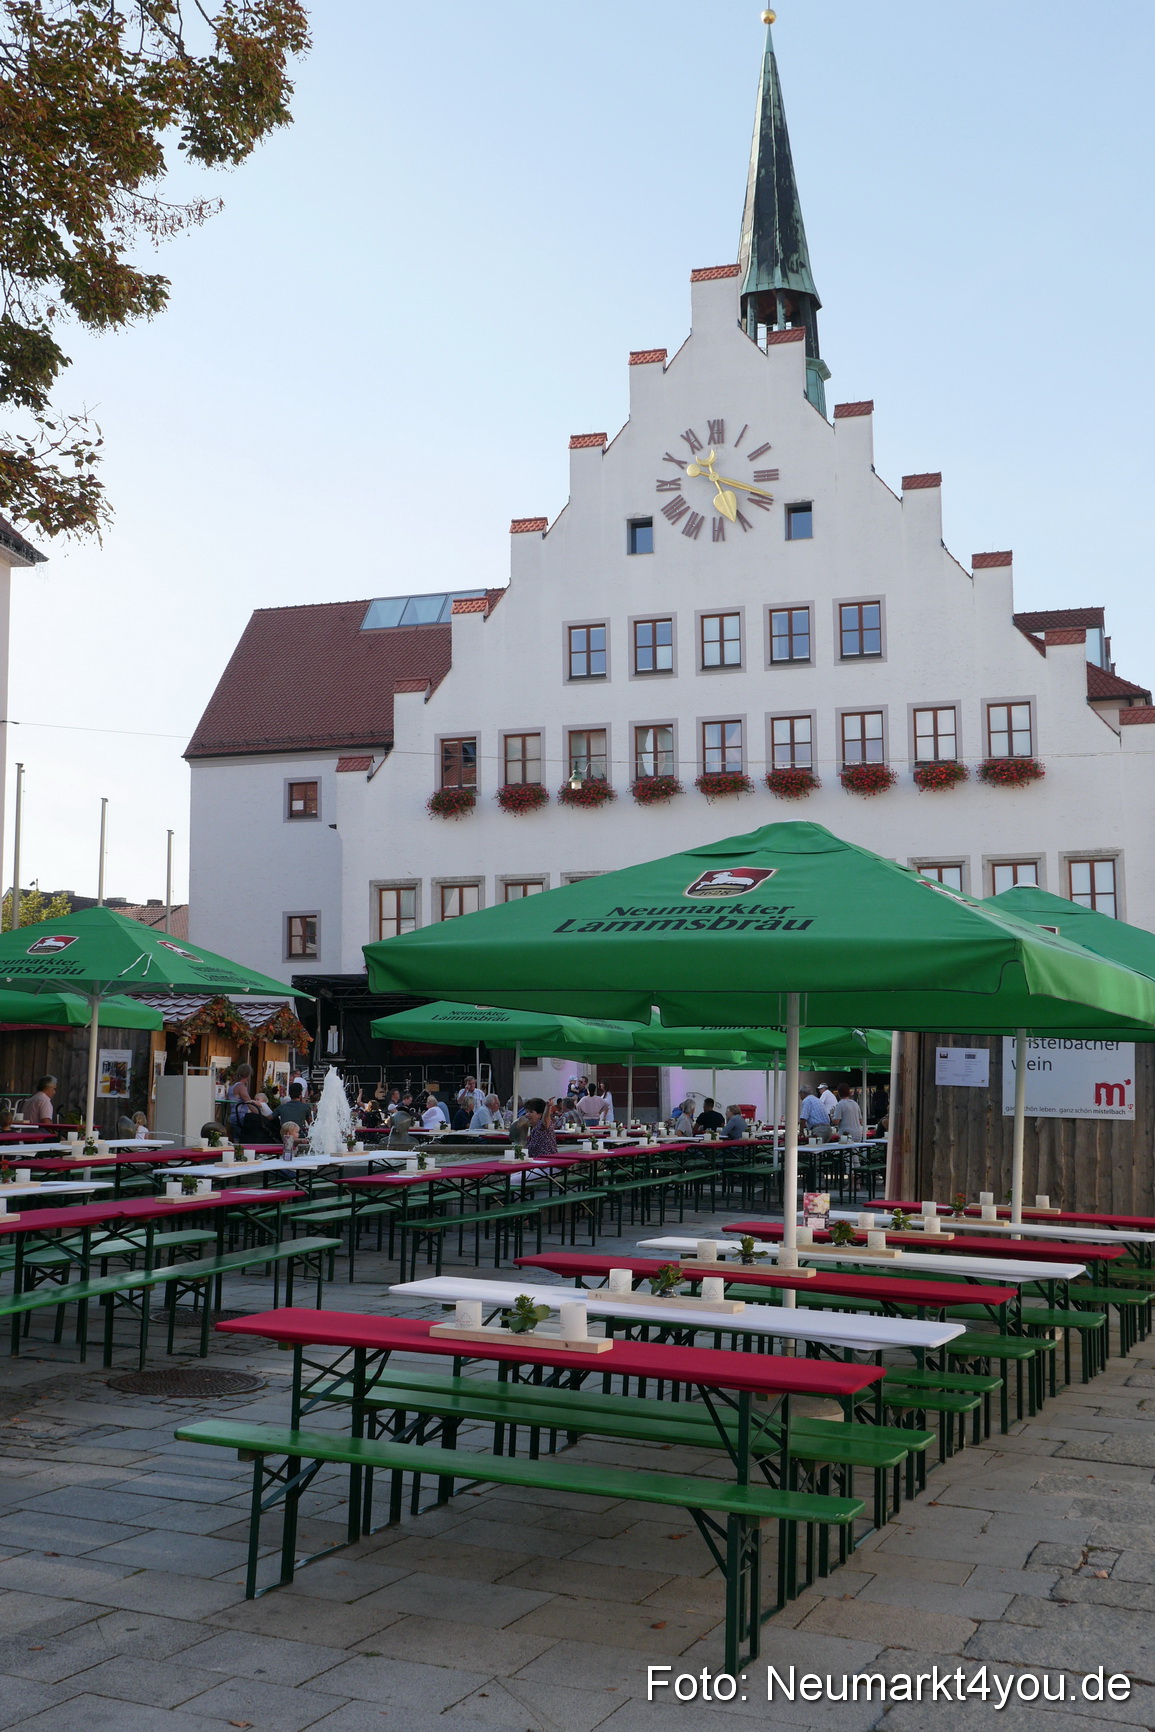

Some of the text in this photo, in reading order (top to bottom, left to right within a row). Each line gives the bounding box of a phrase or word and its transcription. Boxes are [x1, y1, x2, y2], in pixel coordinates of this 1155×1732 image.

[606, 903, 796, 917] Neumarkter
[552, 916, 815, 934] Lammsbräu
[431, 1014, 511, 1023] Lammsbräu
